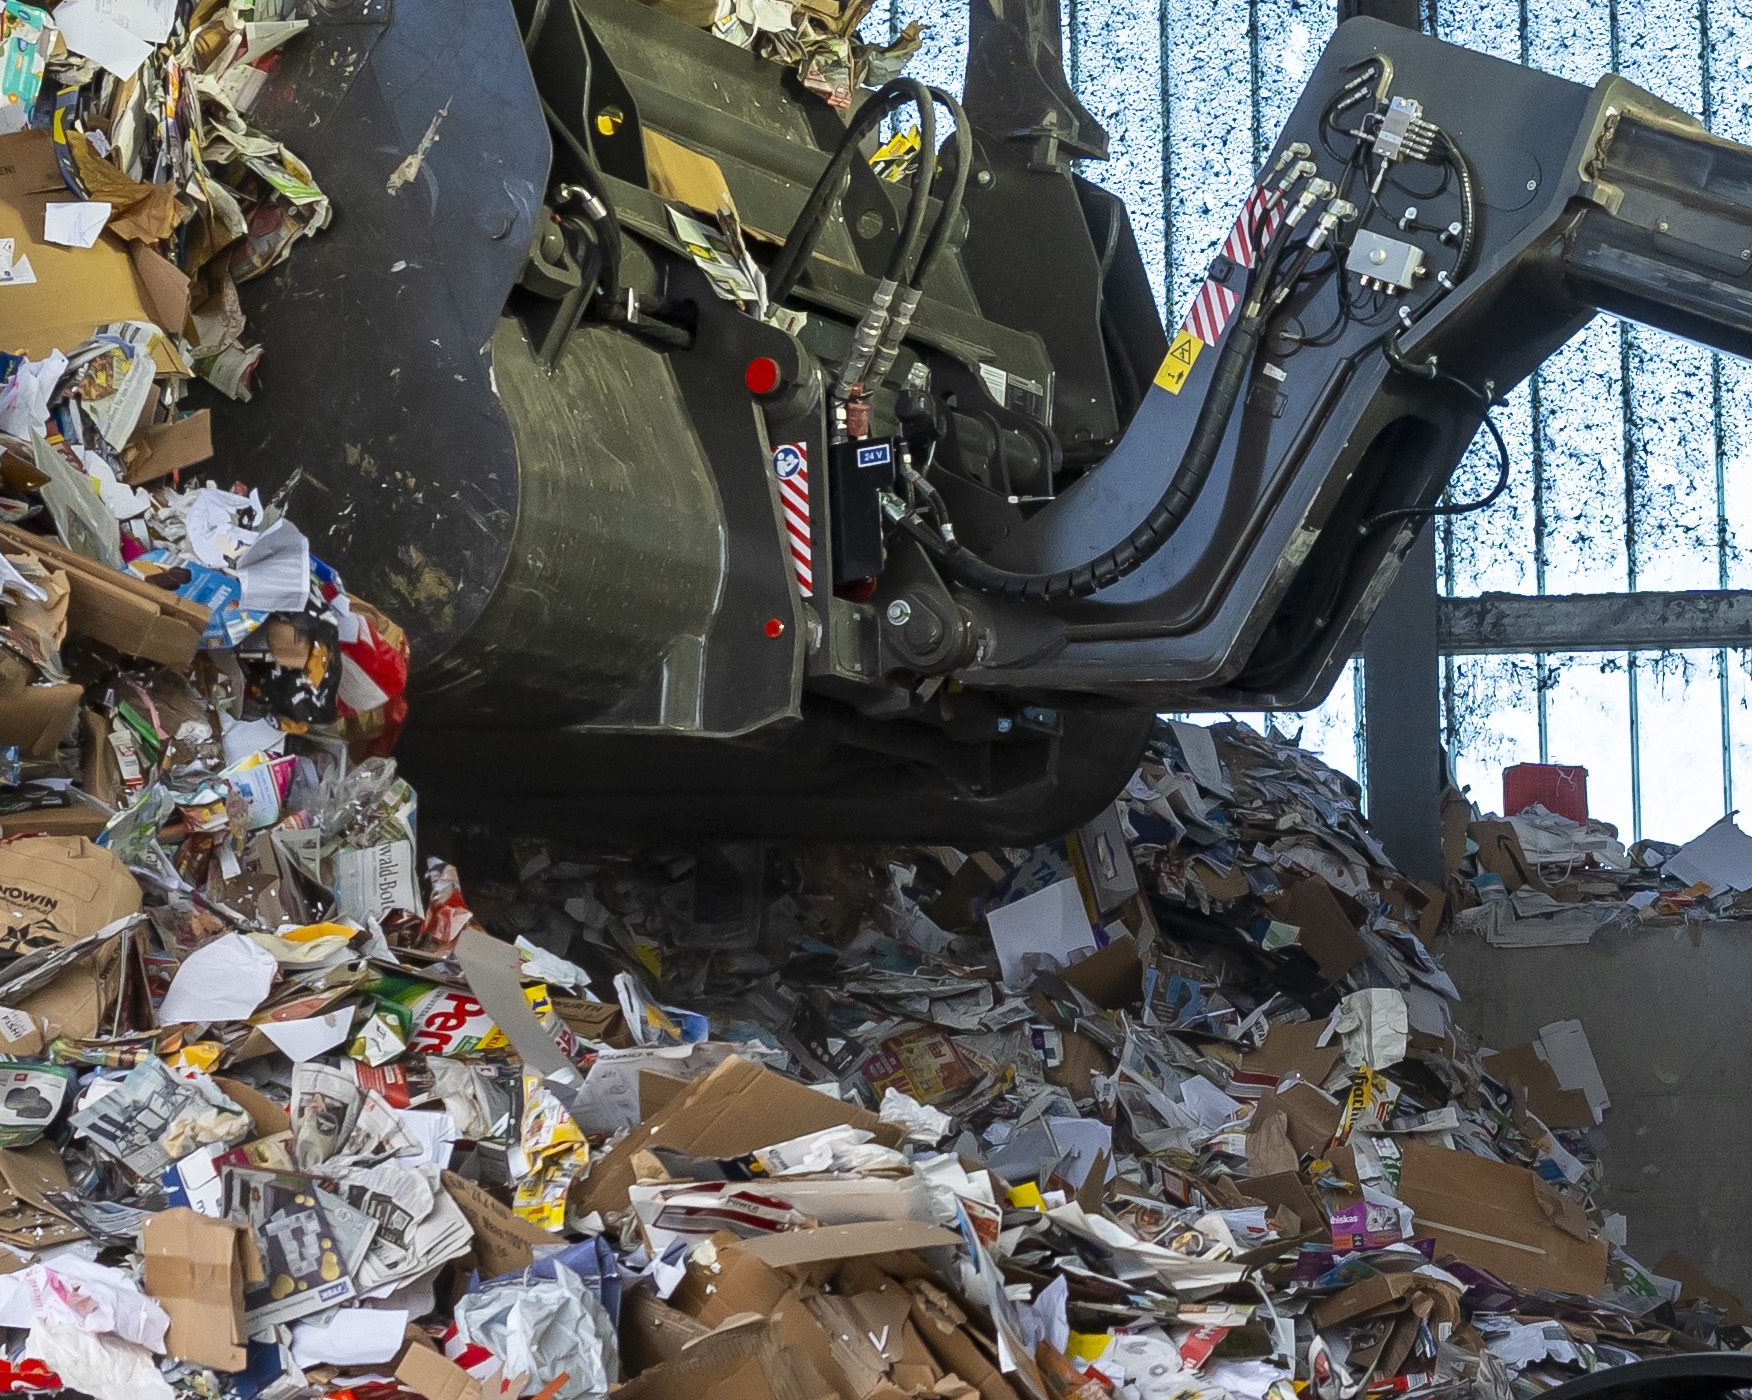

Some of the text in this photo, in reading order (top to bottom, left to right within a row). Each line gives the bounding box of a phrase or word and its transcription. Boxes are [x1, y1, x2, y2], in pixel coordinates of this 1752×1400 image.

[863, 450, 884, 461] 24 V
[1330, 1214, 1359, 1225] hiskas
